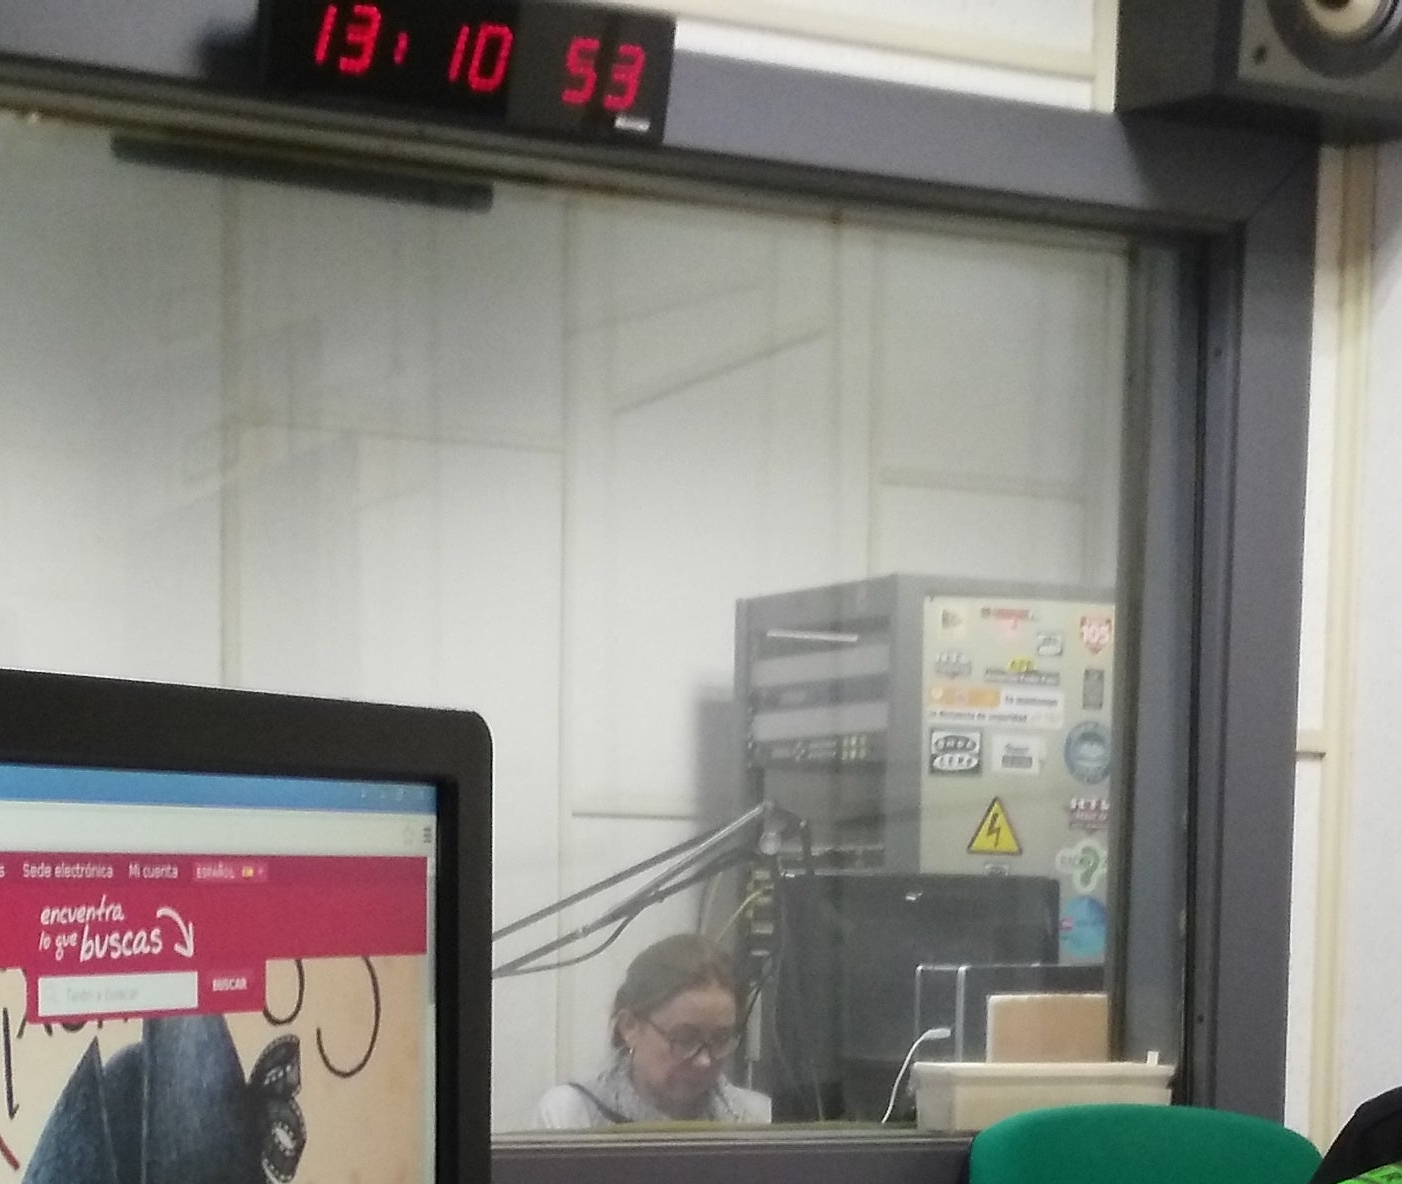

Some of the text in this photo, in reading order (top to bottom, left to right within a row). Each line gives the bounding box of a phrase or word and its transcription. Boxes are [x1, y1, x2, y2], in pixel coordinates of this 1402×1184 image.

[561, 36, 645, 111] 53
[23, 863, 51, 879] Sede
[54, 864, 113, 879] electrónica
[129, 864, 141, 878] Mi
[143, 865, 178, 879] cuenta
[40, 895, 125, 926] encuentra
[39, 926, 163, 963] lo que buscas
[213, 978, 247, 992] BUSCAR
